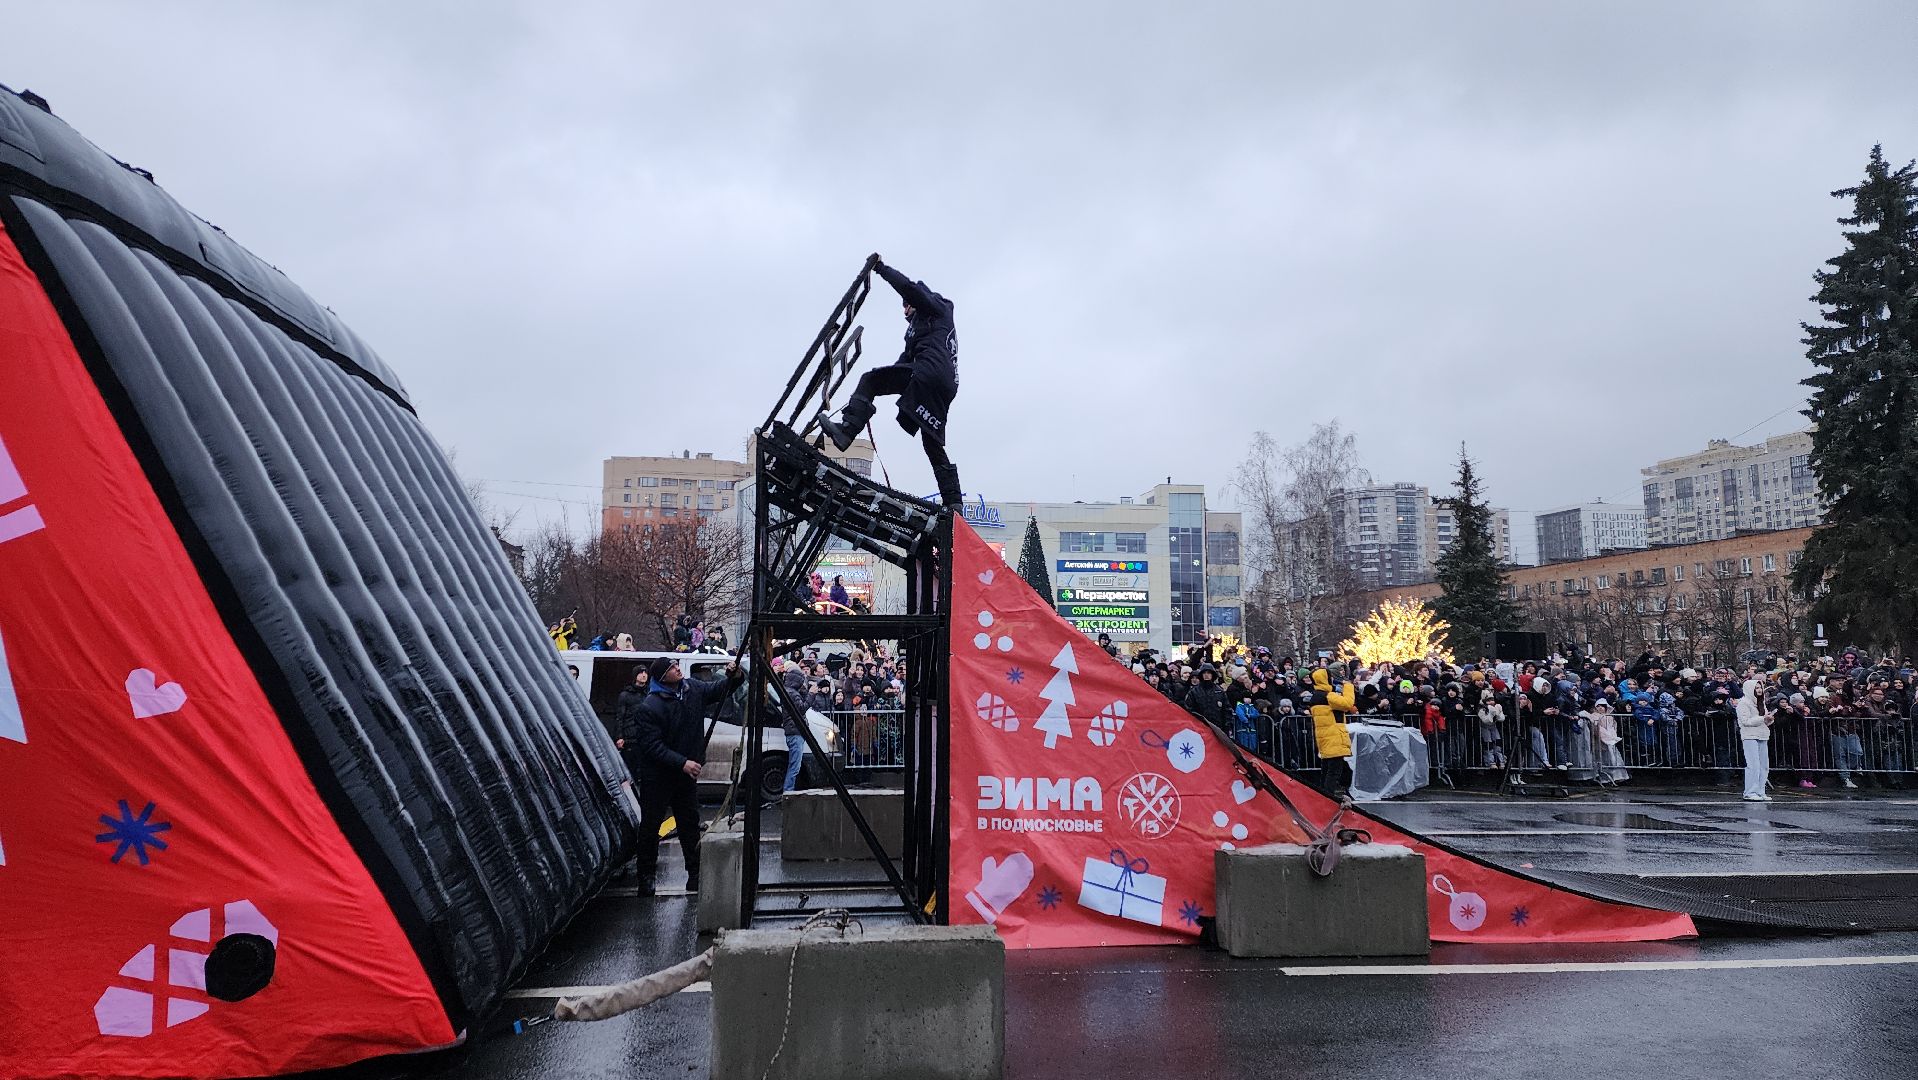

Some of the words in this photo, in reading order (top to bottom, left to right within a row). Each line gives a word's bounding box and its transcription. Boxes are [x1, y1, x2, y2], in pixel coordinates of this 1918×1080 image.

[1064, 561, 1093, 569] Детский
[1094, 562, 1109, 570] мир
[1071, 606, 1136, 616] СУПЕРМАРКЕТ
[1075, 620, 1147, 629] ЭКСТРОDENT
[977, 775, 1103, 811] ЗИМА
[991, 817, 1104, 834] ПОДМОСКОВЬЕ
[1141, 818, 1160, 836] 13
